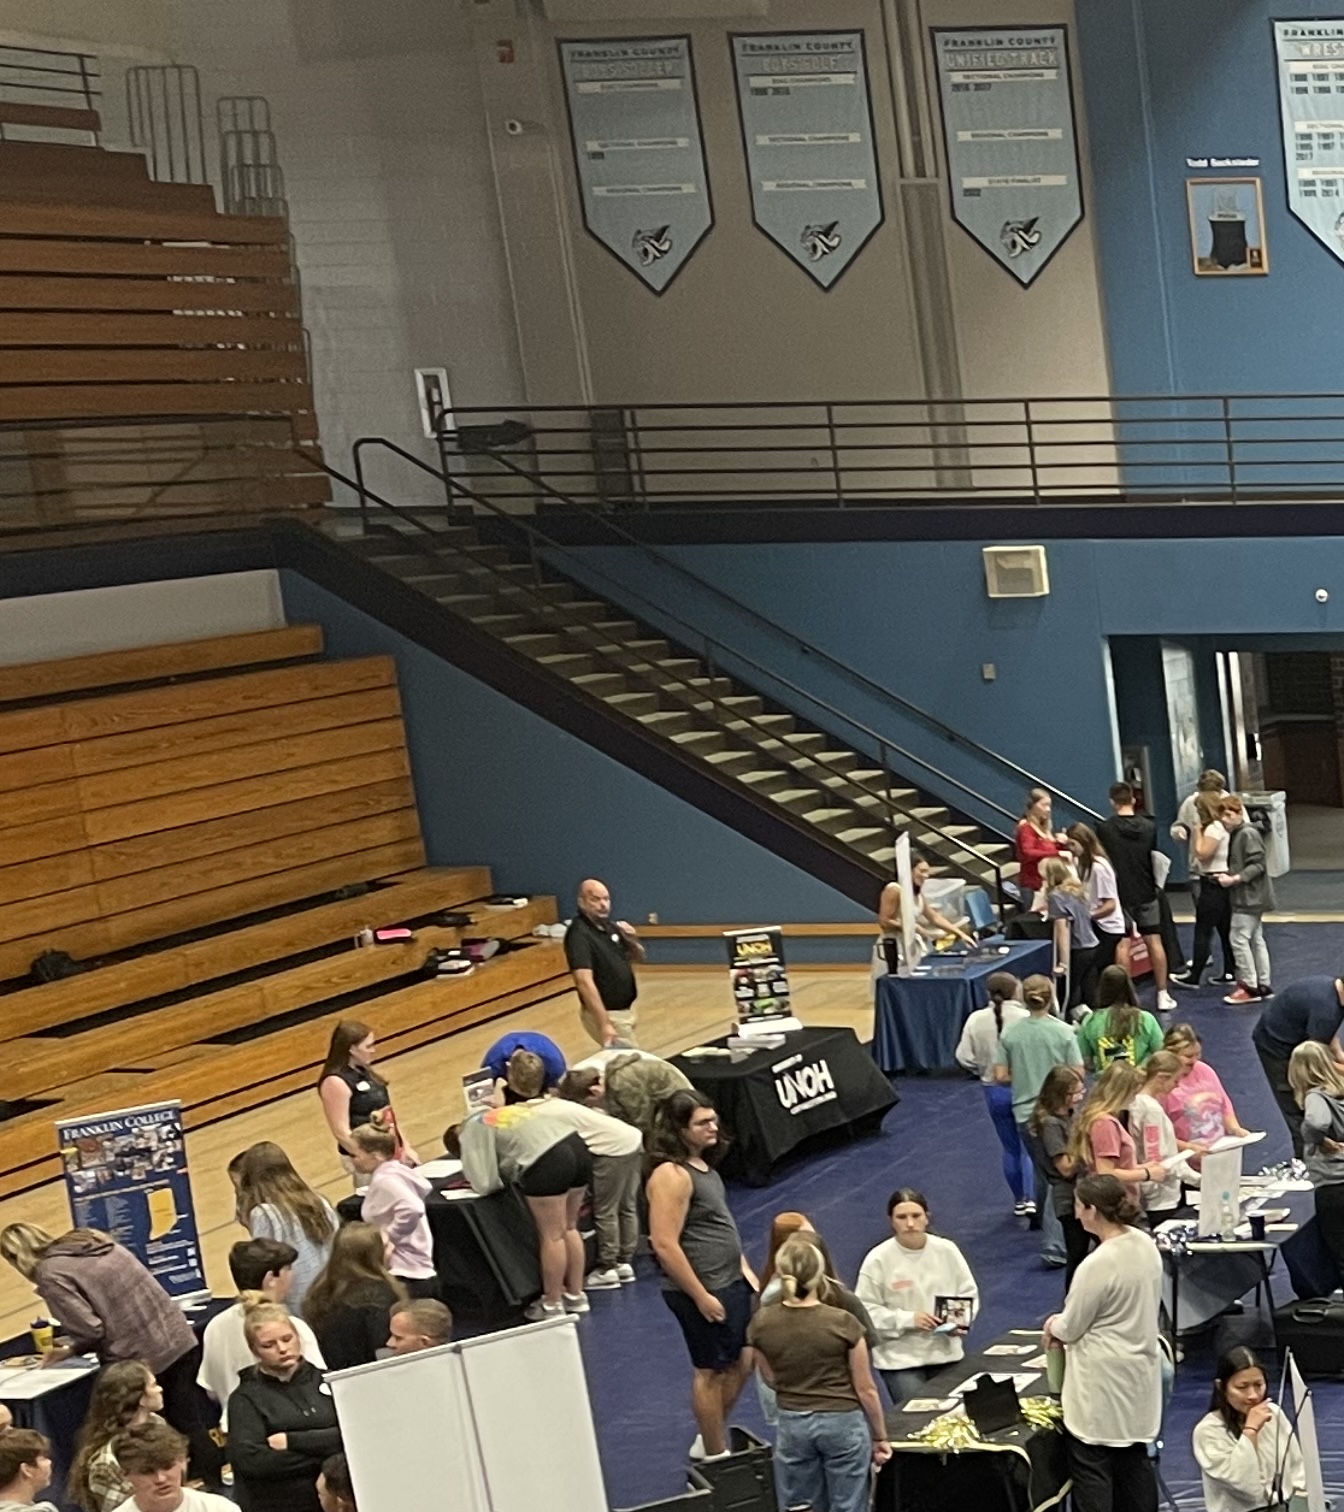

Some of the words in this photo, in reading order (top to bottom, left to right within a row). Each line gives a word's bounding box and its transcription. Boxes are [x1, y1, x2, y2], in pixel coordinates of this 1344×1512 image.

[1283, 26, 1344, 37] FRANKLIN
[1009, 50, 1058, 66] TRACK
[736, 941, 773, 957] UNOH
[774, 1059, 835, 1109] UNOH
[63, 1120, 124, 1141] FRANKLIN
[124, 1109, 176, 1129] COLLEGE
